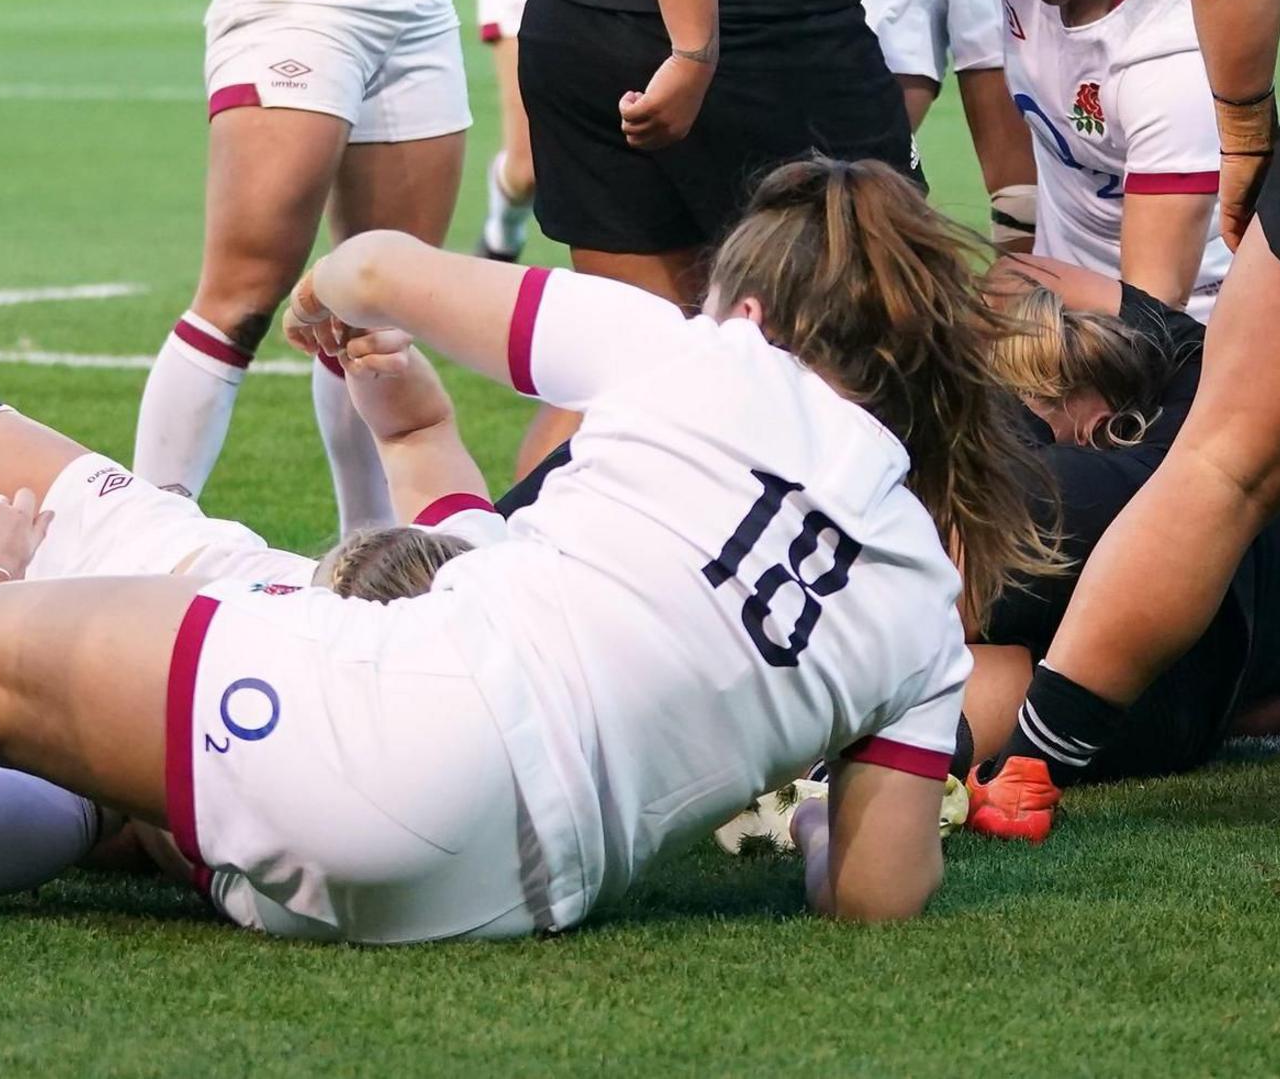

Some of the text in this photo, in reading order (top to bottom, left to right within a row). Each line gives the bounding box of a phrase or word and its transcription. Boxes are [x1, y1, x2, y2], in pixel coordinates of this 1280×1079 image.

[271, 80, 308, 90] umbro
[701, 468, 863, 667] 18
[205, 677, 280, 754] O2
